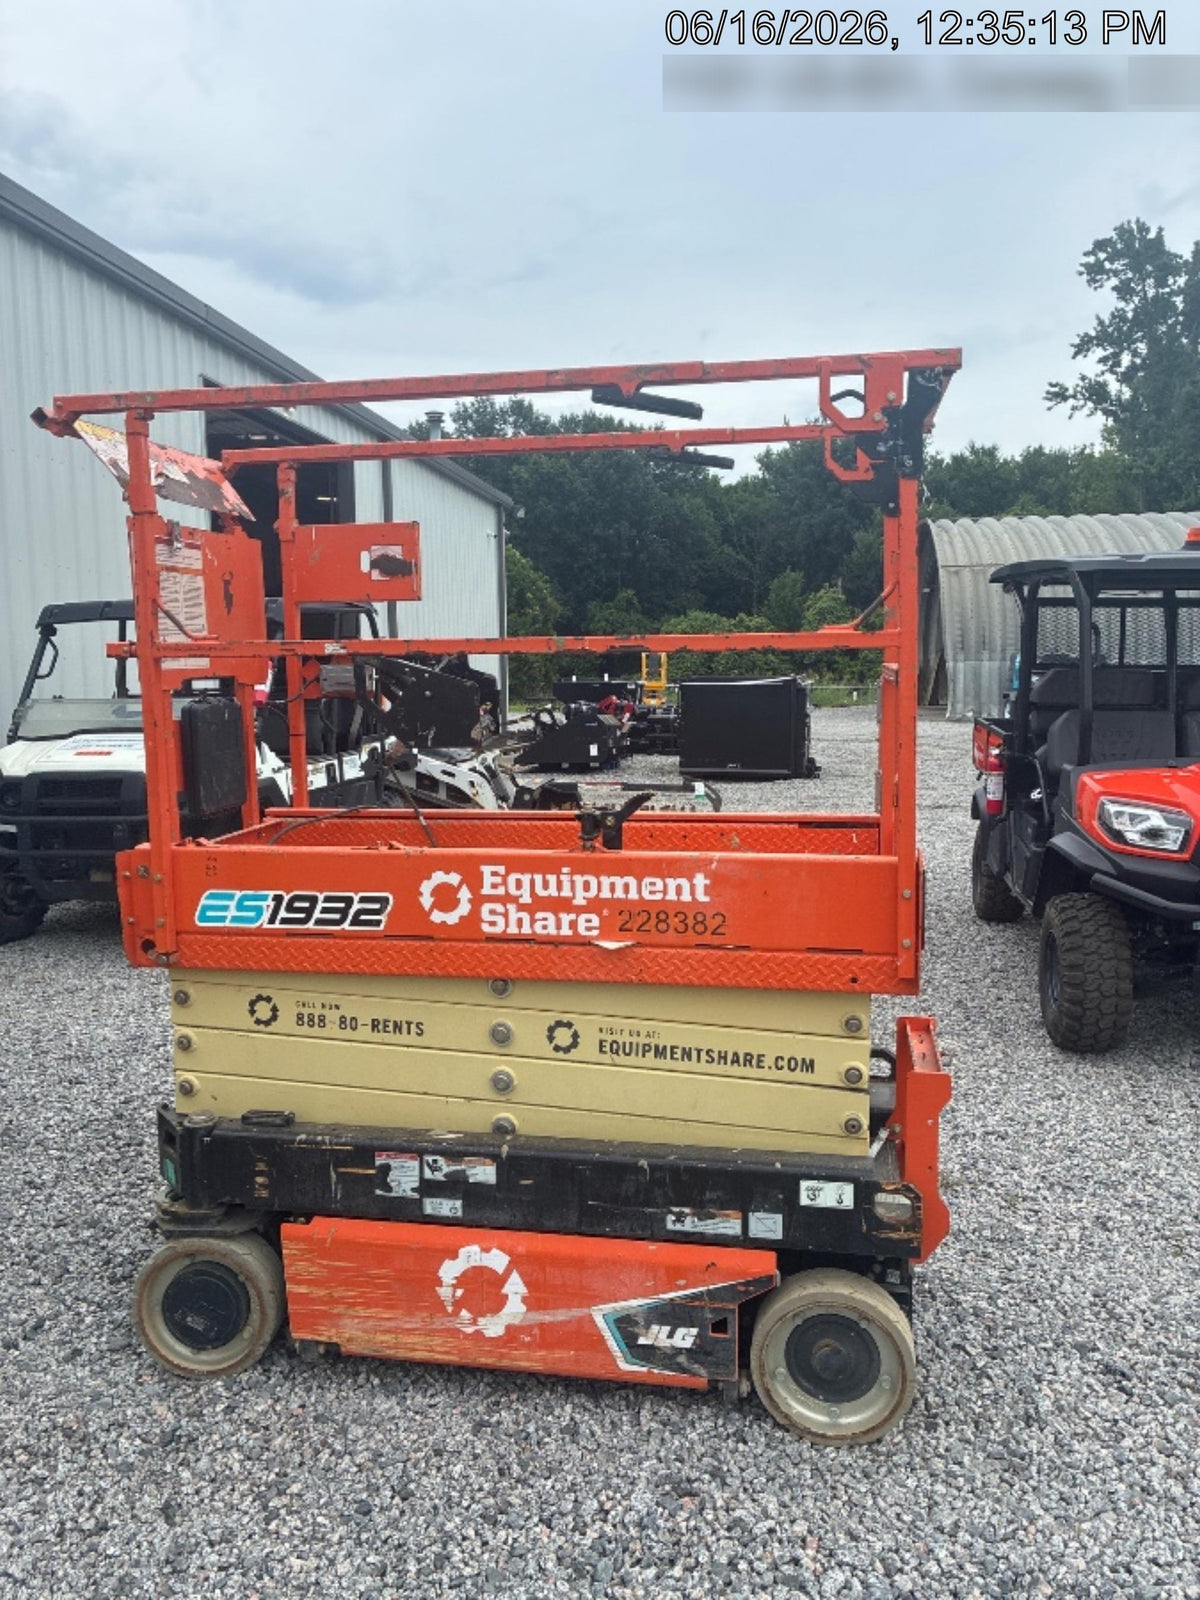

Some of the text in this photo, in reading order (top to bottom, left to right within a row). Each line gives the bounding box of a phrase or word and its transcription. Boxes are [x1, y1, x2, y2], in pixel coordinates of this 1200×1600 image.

[480, 865, 710, 905] Equipment
[196, 890, 392, 930] ES1932
[480, 902, 600, 936] Share
[618, 910, 727, 936] 228382
[598, 1038, 816, 1075] EQUIPMENTSHARE.COM
[636, 1324, 700, 1349] JLG
